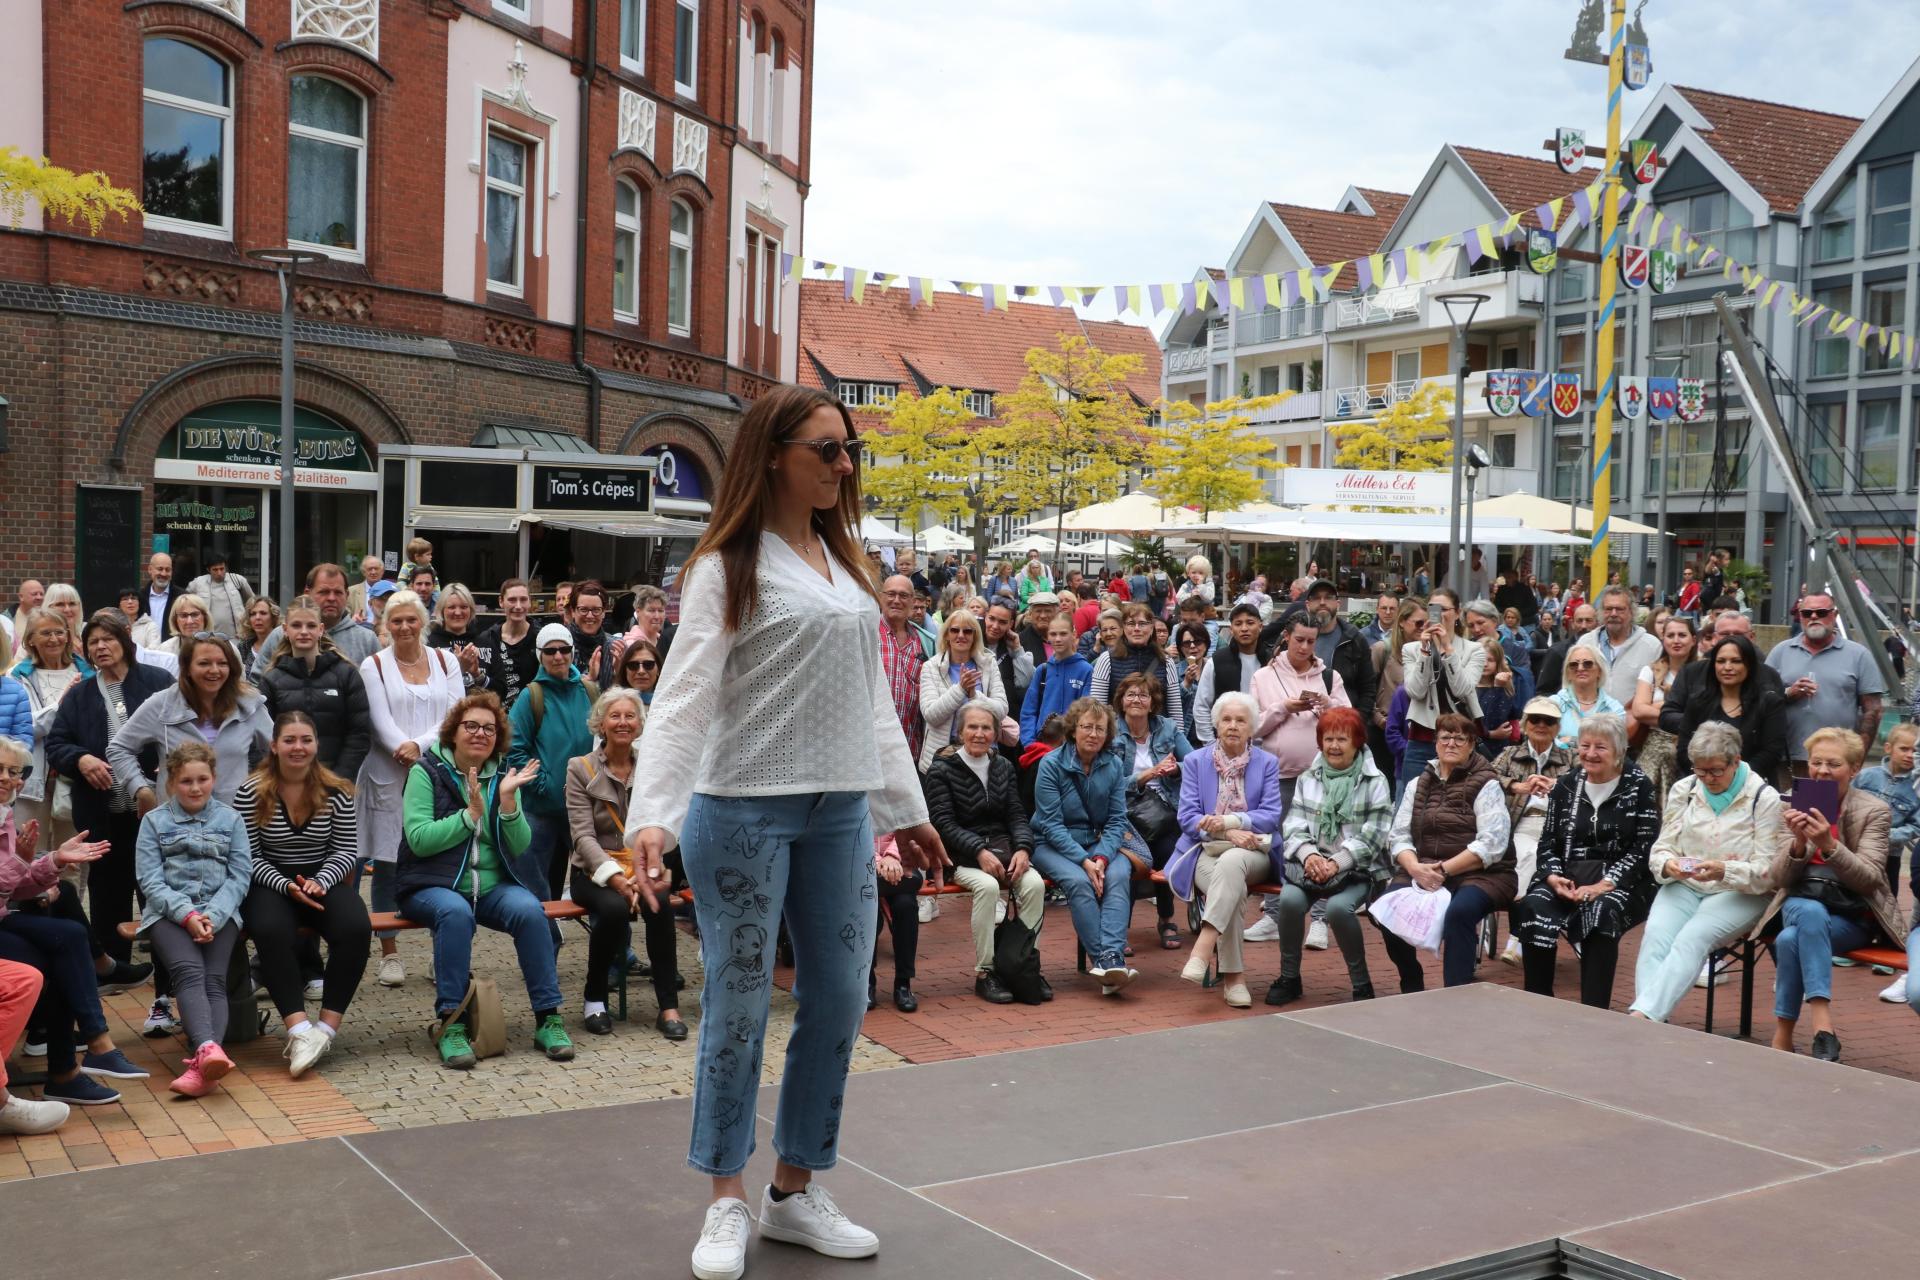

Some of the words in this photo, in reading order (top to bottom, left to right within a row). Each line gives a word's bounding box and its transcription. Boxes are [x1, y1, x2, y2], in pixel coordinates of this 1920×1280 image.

[185, 427, 222, 449] DIE
[225, 453, 261, 463] schenken
[264, 456, 272, 464] &
[274, 458, 307, 467] gßen
[197, 464, 270, 480] Mediterrane
[274, 469, 347, 485] Szialitäten
[1336, 473, 1389, 490] Müllers
[1392, 474, 1417, 490] Eck
[592, 481, 635, 500] Crêpes
[156, 503, 179, 518] DIE
[166, 521, 202, 530] schenken
[204, 522, 212, 530] &
[214, 523, 248, 532] genießen
